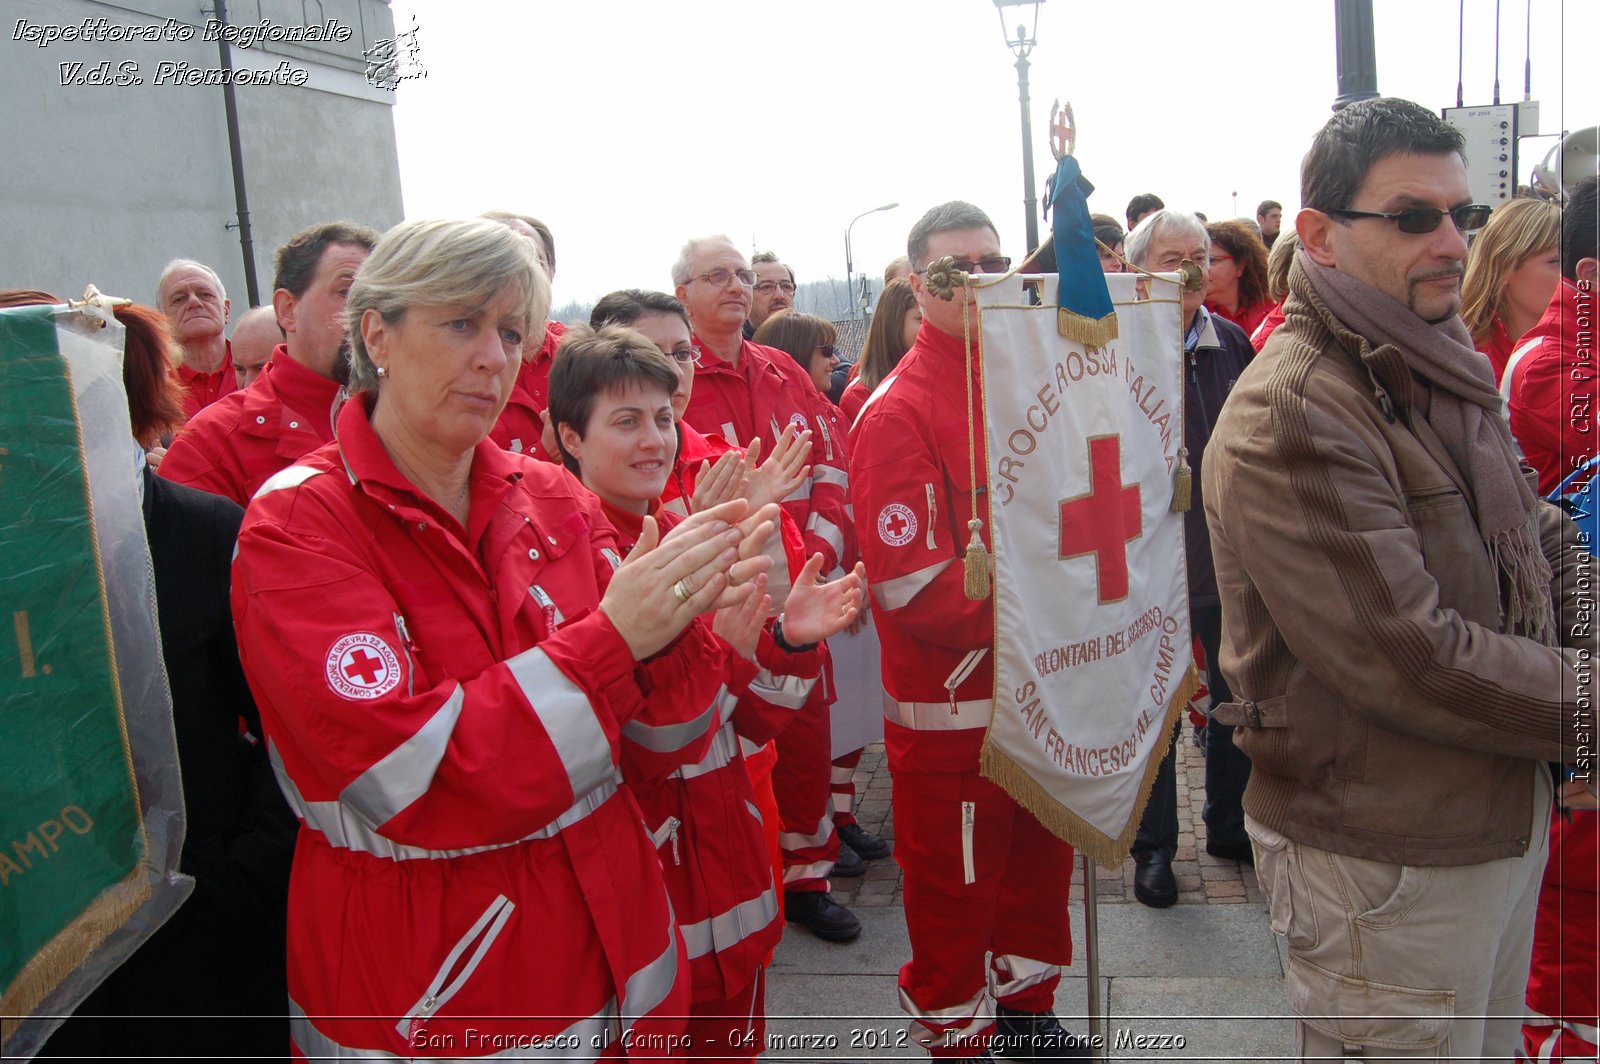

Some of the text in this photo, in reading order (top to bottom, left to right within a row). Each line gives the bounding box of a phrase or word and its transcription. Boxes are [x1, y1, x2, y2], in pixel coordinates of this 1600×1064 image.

[996, 383, 1061, 507] CROCE
[1055, 347, 1118, 394] ROSSA
[335, 635, 368, 654] GINEVRA
[369, 637, 381, 647] 22
[1106, 631, 1127, 658] DEL
[330, 653, 338, 662] DI
[380, 646, 399, 679] AGOSTO
[329, 663, 372, 697] CONVENZIONE
[1015, 615, 1179, 777] SAN FRANCESCO AL CAMPO
